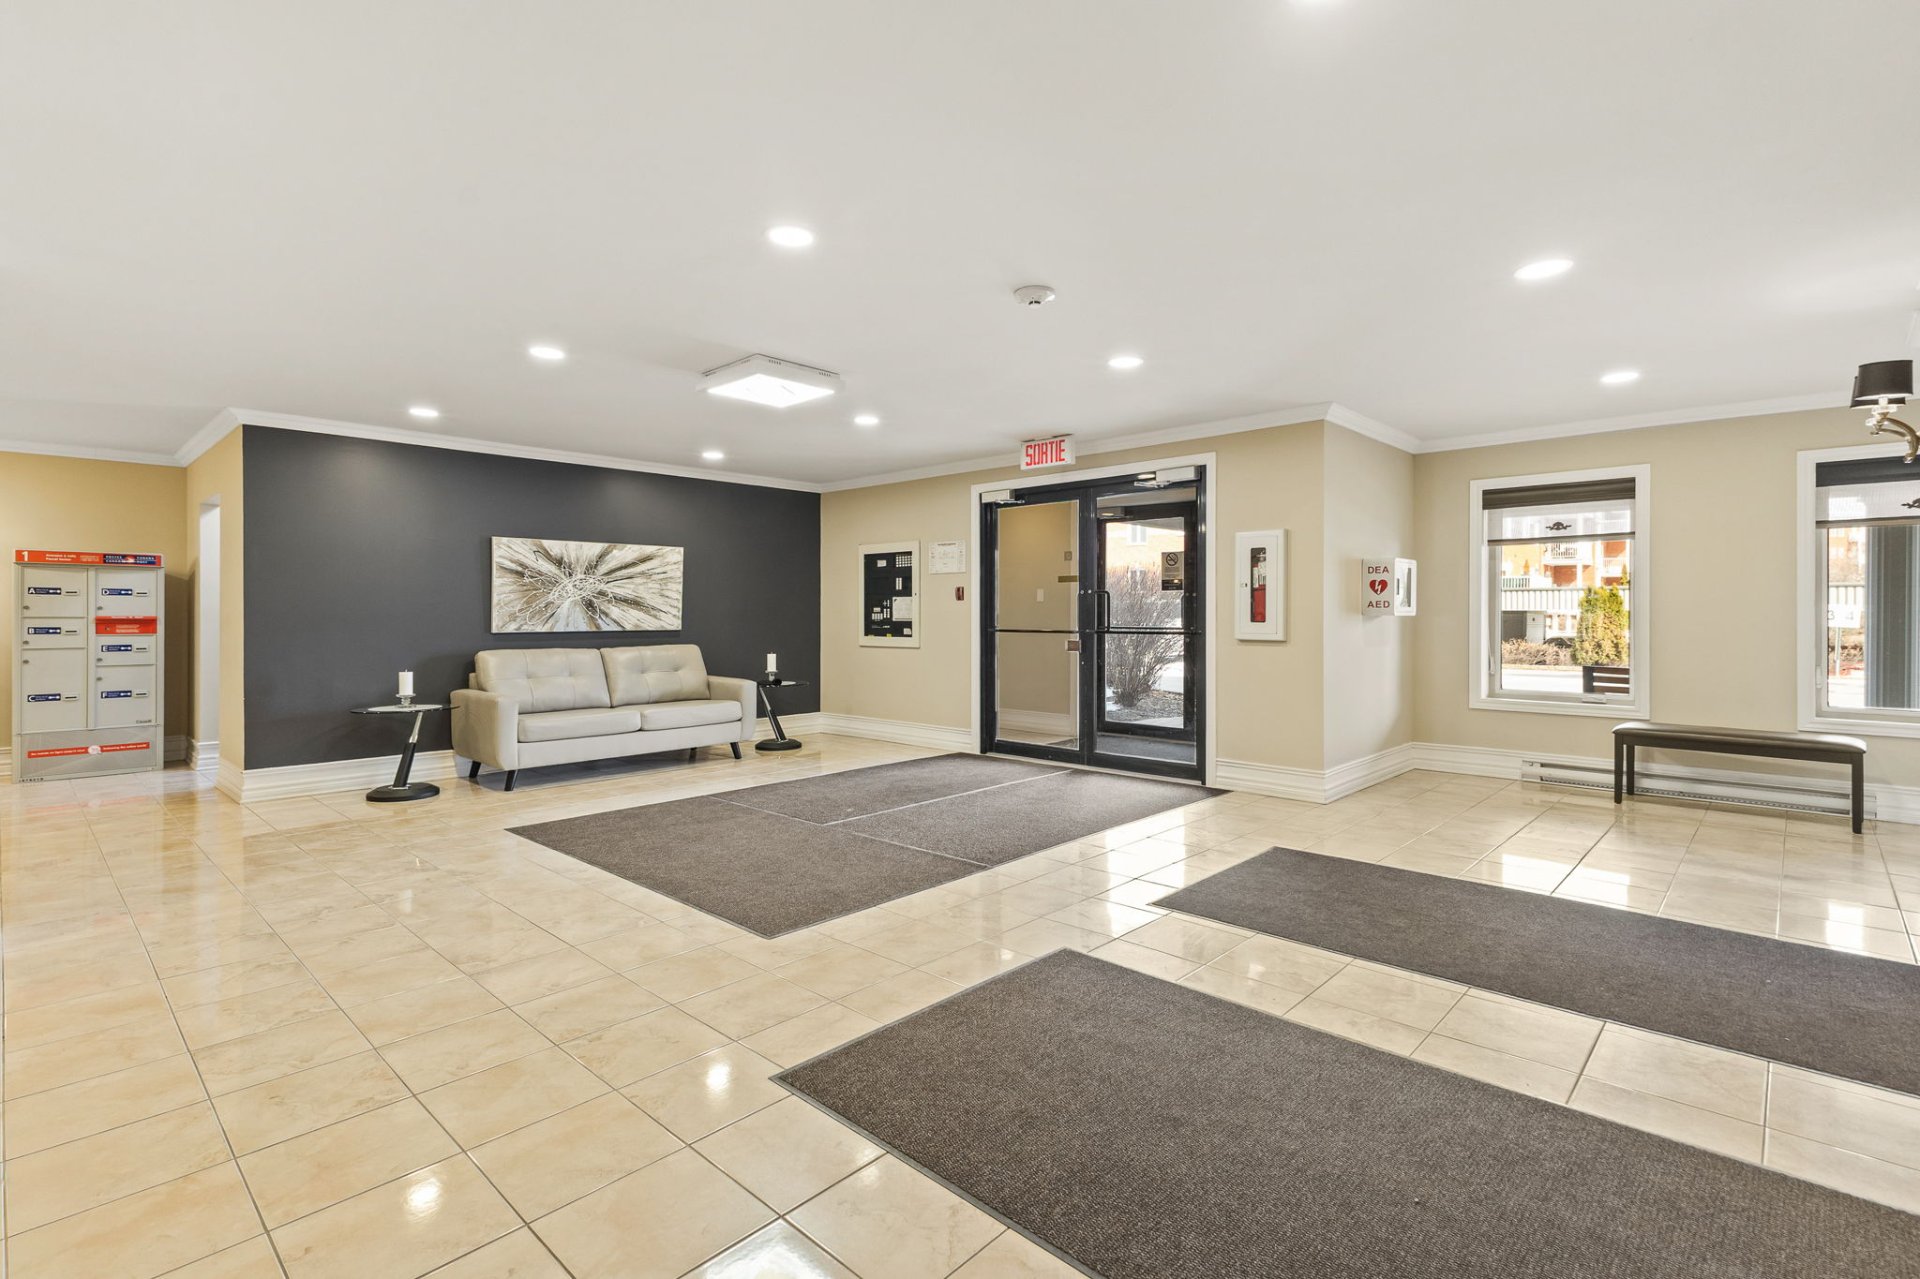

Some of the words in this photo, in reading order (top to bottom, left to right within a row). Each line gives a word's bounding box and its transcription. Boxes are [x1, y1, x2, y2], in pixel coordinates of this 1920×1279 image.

[1025, 439, 1066, 467] SORTIE
[21, 551, 29, 562] 1
[1367, 566, 1390, 574] DEA
[28, 587, 36, 595] A
[102, 588, 110, 596] D
[1367, 600, 1391, 609] AED
